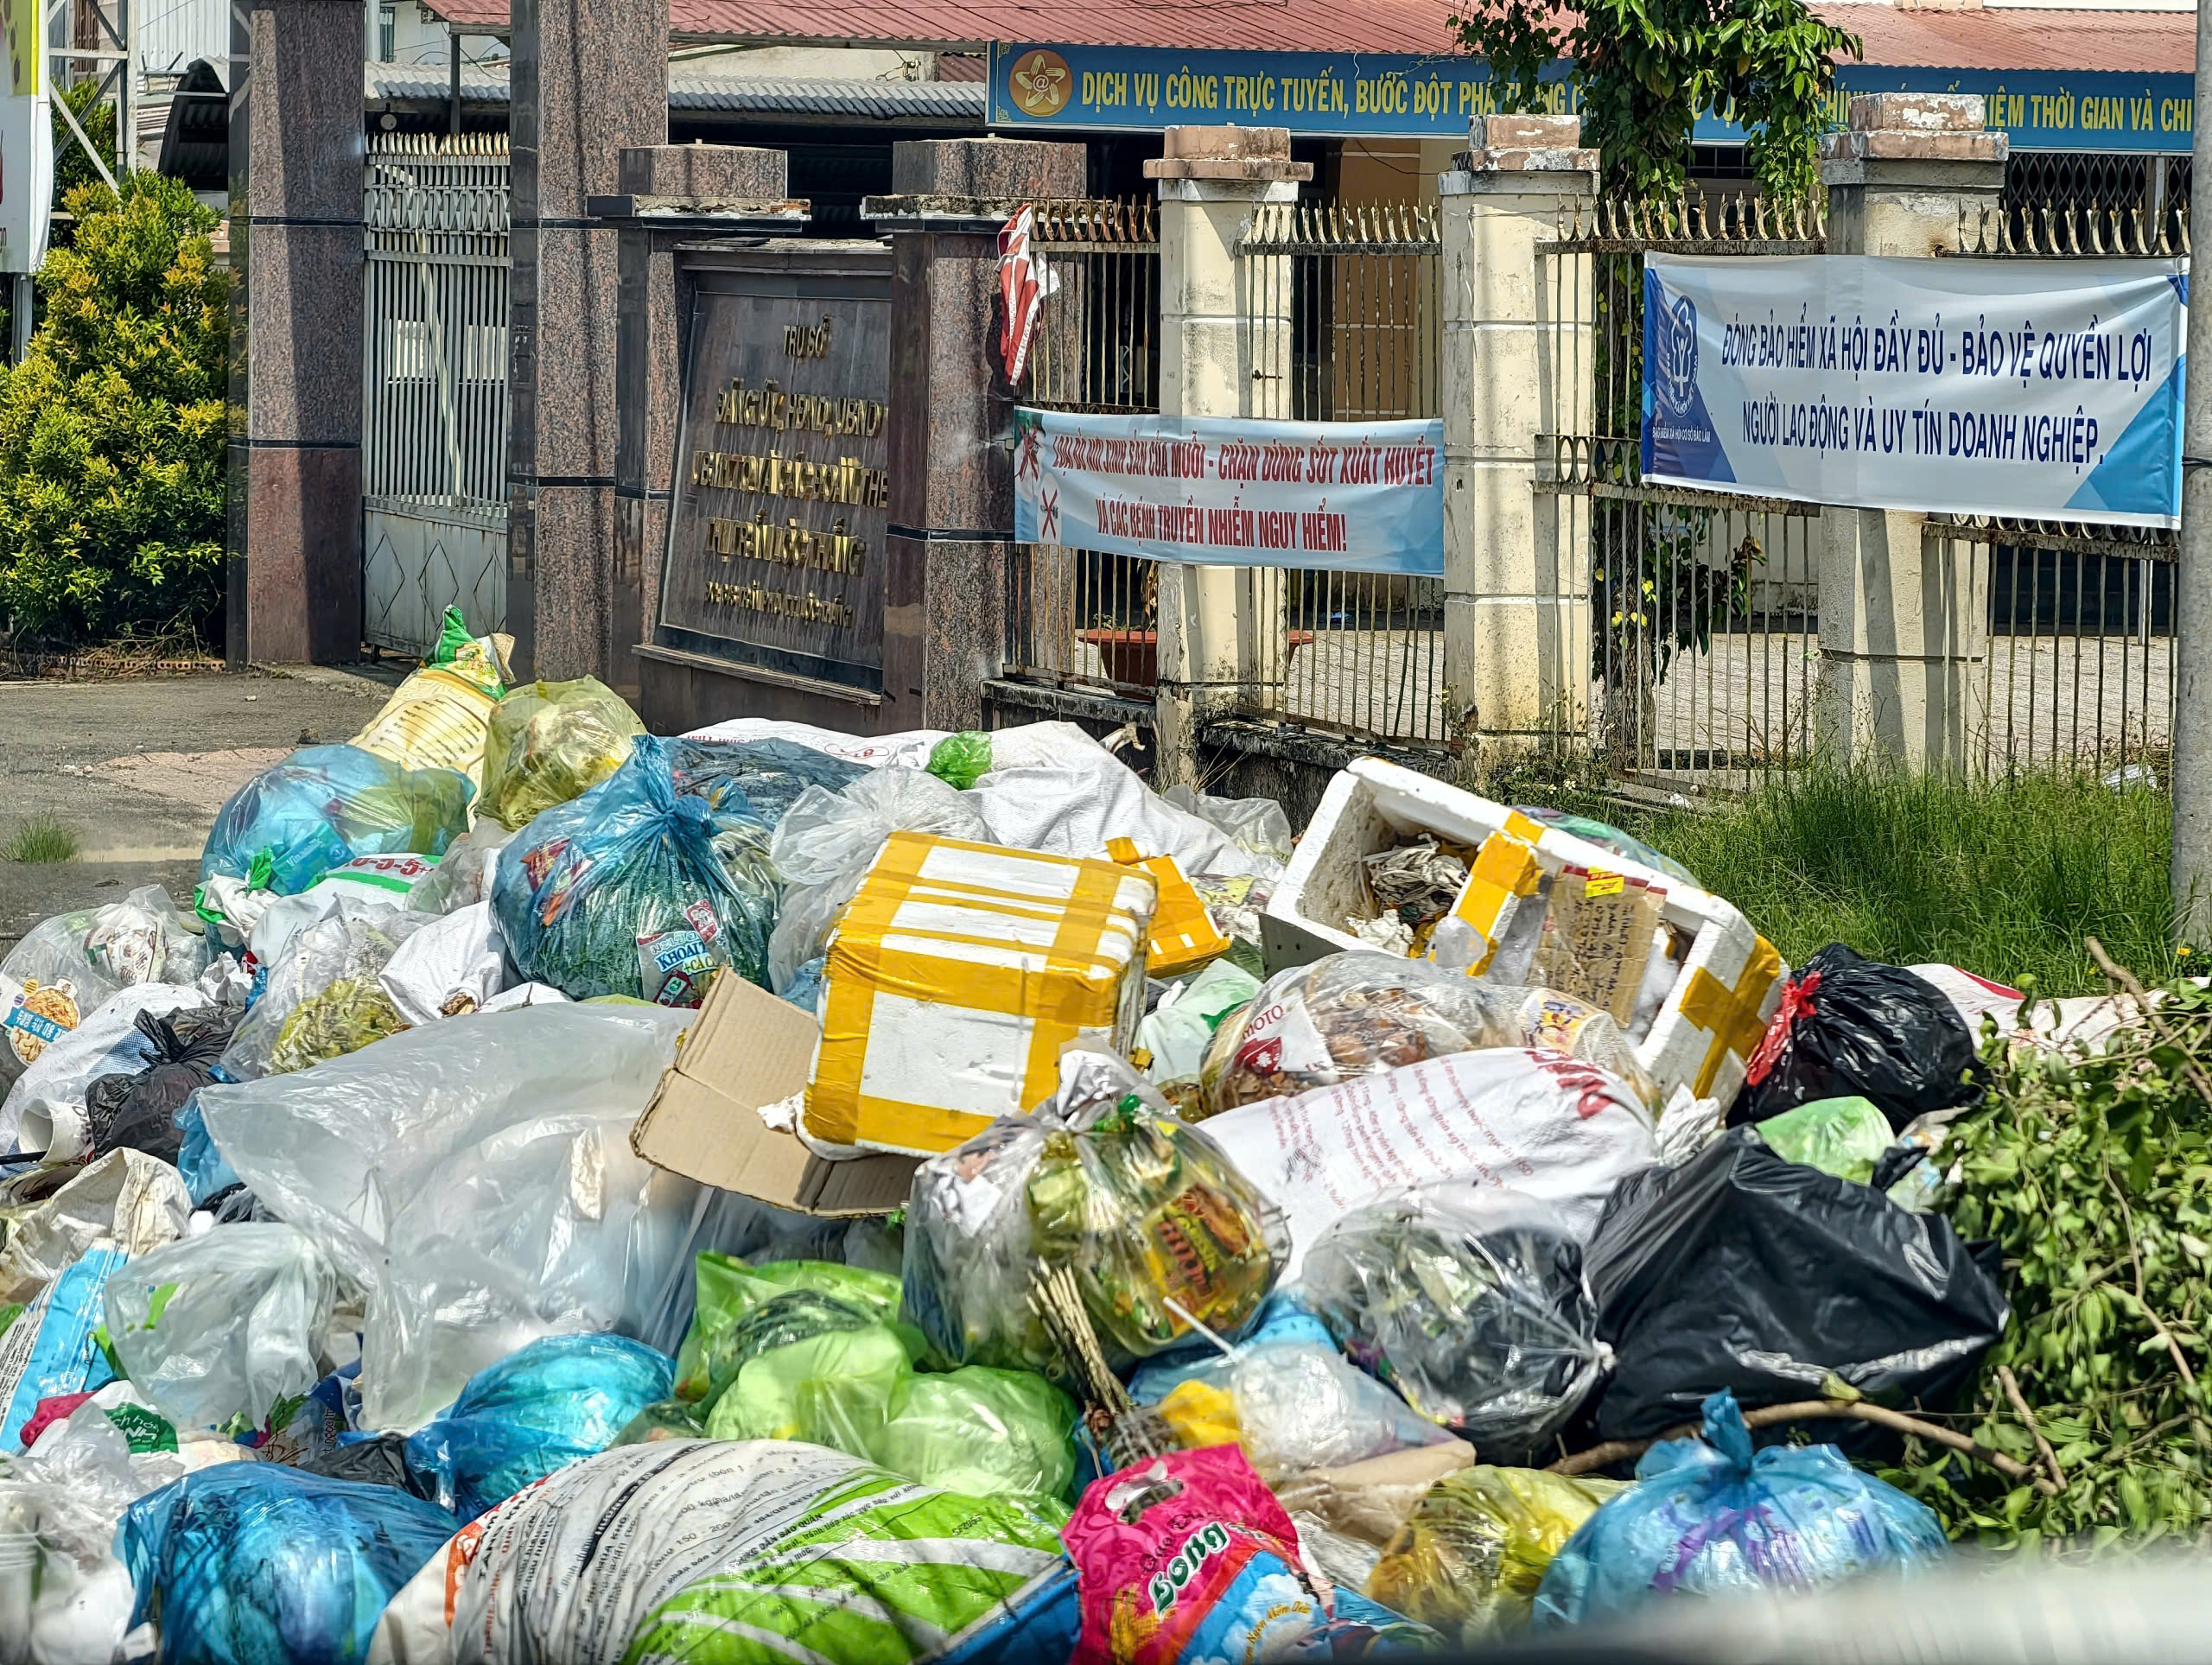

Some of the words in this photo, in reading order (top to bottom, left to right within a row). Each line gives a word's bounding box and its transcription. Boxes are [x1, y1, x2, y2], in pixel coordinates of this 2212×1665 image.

[1082, 72, 1127, 113] DỊCH
[1134, 73, 1159, 114] VỤ
[1166, 65, 1218, 109] CÔNG
[1224, 70, 1275, 118] TRỰC
[1281, 65, 1349, 119] TUYẾN,
[1355, 72, 1408, 114] BƯỚC
[1414, 72, 1452, 121] ĐỘT
[1459, 72, 1496, 115] PHÁ
[2031, 86, 2075, 129] THỜI
[2081, 96, 2124, 131] GIAN
[2130, 89, 2154, 131] VÀ
[2161, 98, 2192, 132] CHI
[1721, 313, 1758, 367] ĐÓNG
[1758, 308, 1784, 369] BẢO
[1786, 302, 1815, 370] HIỂM
[1818, 315, 1837, 370] XÃ
[1841, 315, 1868, 382] HỘI
[1874, 309, 1912, 373] ĐẦY
[1917, 312, 1944, 375] ĐỦ
[1962, 314, 2005, 377] BẢO
[2009, 320, 2036, 389] VỆ
[2039, 314, 2111, 381] QUYỀN
[2117, 327, 2152, 393] LỢI
[1172, 430, 1205, 478] MUỖI
[1218, 437, 1260, 488] CHẶN
[1262, 438, 1304, 482] ĐỨNG
[1306, 435, 1338, 484] SỐT
[1340, 435, 1382, 485] XUẤT
[1384, 435, 1435, 485] HUYẾT
[1743, 391, 1779, 446] NGƯỜI
[1783, 404, 1806, 448] LAO
[1810, 394, 1848, 459] ĐỘNG
[1854, 396, 1877, 452] VÀ
[1883, 408, 1906, 454] UY
[1912, 398, 1942, 455] TÍN
[1948, 411, 2017, 460] DOANH
[1109, 493, 1128, 537] CÁC
[1130, 495, 1155, 546] BỆNH
[1158, 495, 1204, 544] TRUYỀN
[1208, 496, 1255, 547] NHIỄM
[1259, 511, 1296, 550] NGUY
[1302, 498, 1347, 552] HIỂM!
